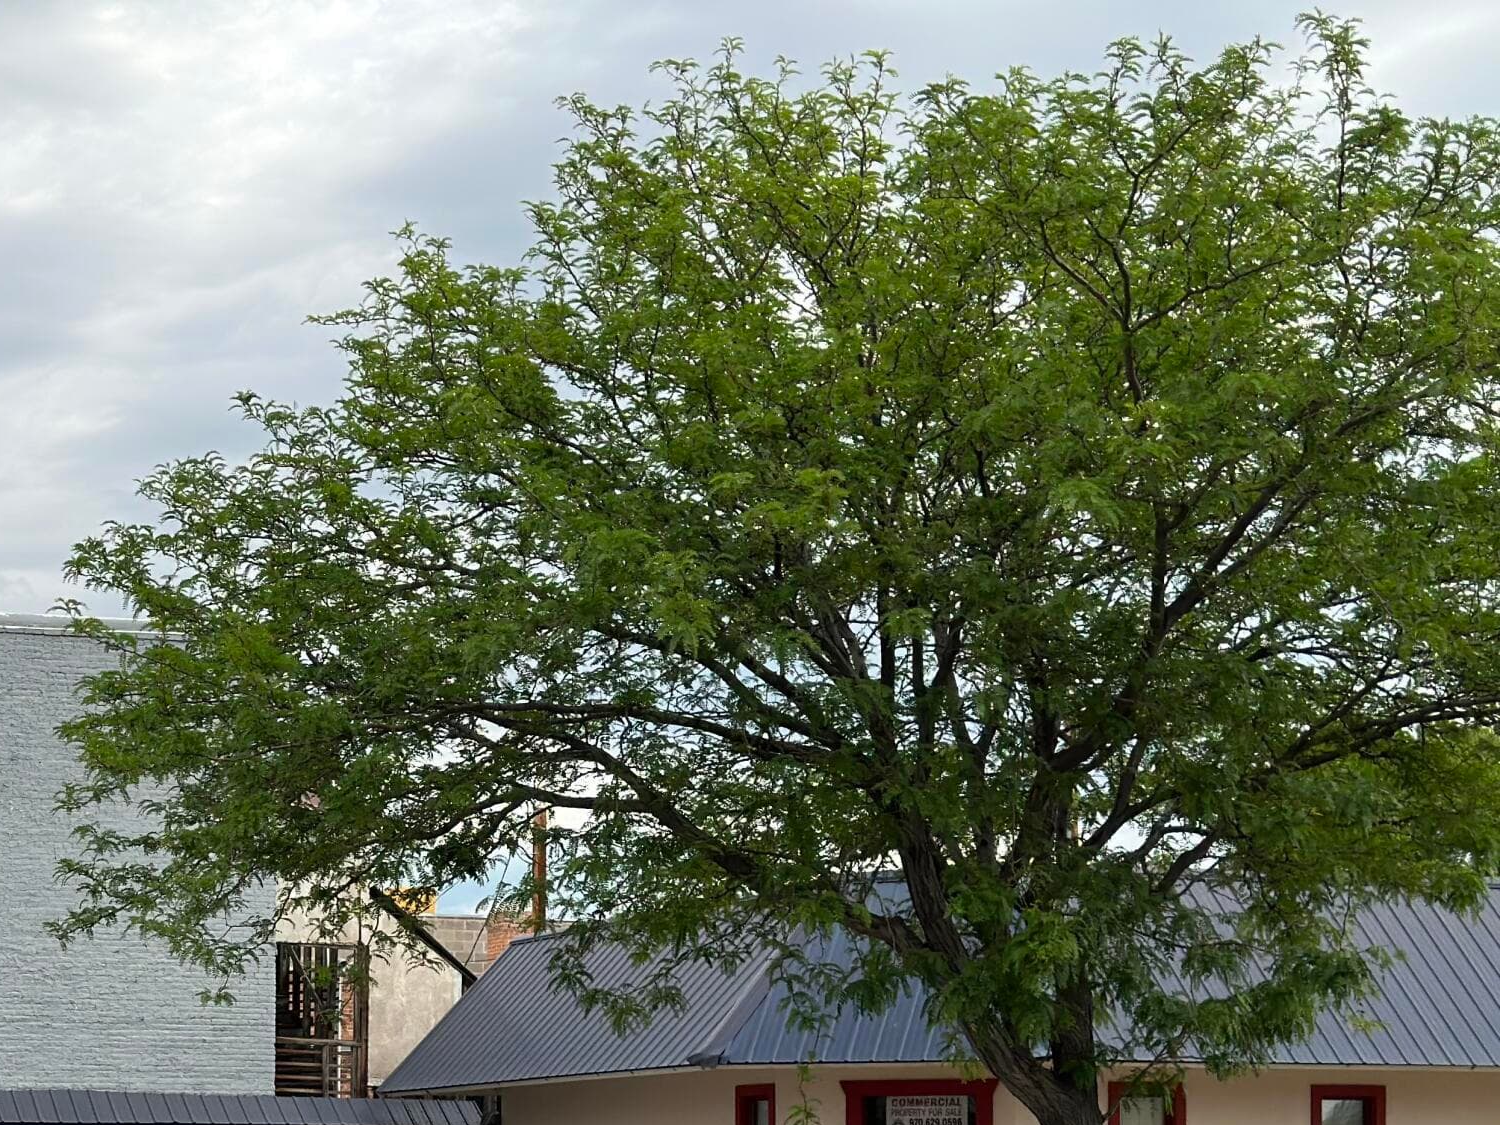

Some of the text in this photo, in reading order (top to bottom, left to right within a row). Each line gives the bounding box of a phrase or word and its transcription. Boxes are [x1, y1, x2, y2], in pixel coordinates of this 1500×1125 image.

[891, 1097, 962, 1107] COMMERCIAL
[891, 1108, 963, 1116] PROPERTY FOR SALE
